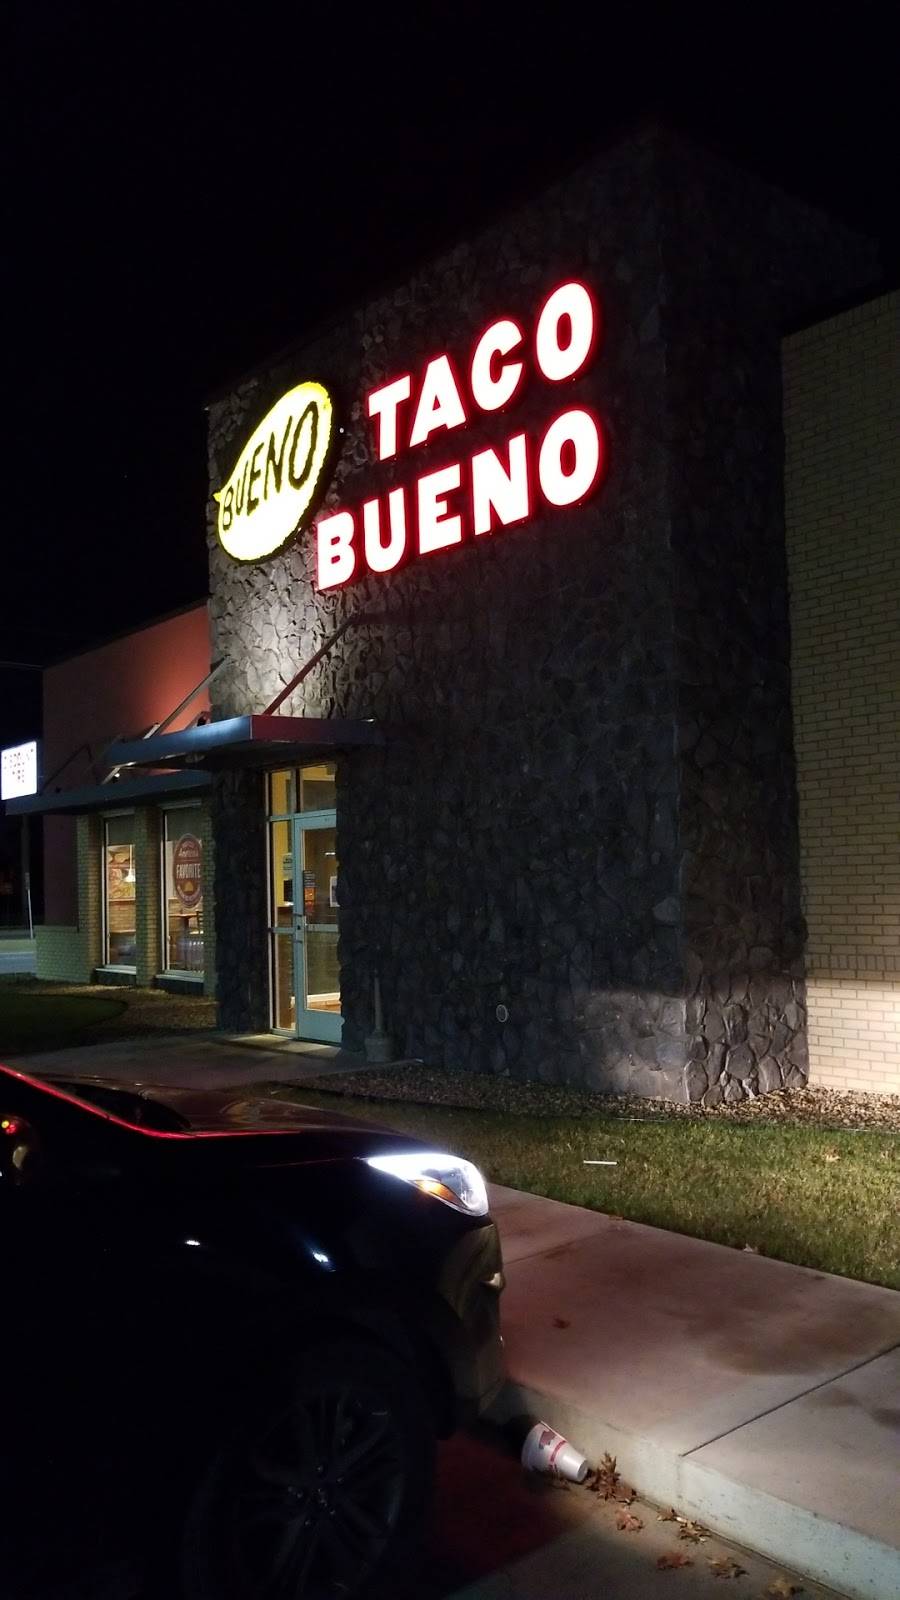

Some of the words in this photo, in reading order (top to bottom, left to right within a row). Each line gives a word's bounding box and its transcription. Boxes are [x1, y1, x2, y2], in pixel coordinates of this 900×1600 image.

[367, 282, 594, 461] TACO
[222, 401, 319, 531] BUENO
[315, 409, 600, 592] BUENO
[176, 863, 201, 879] FAVORITE
